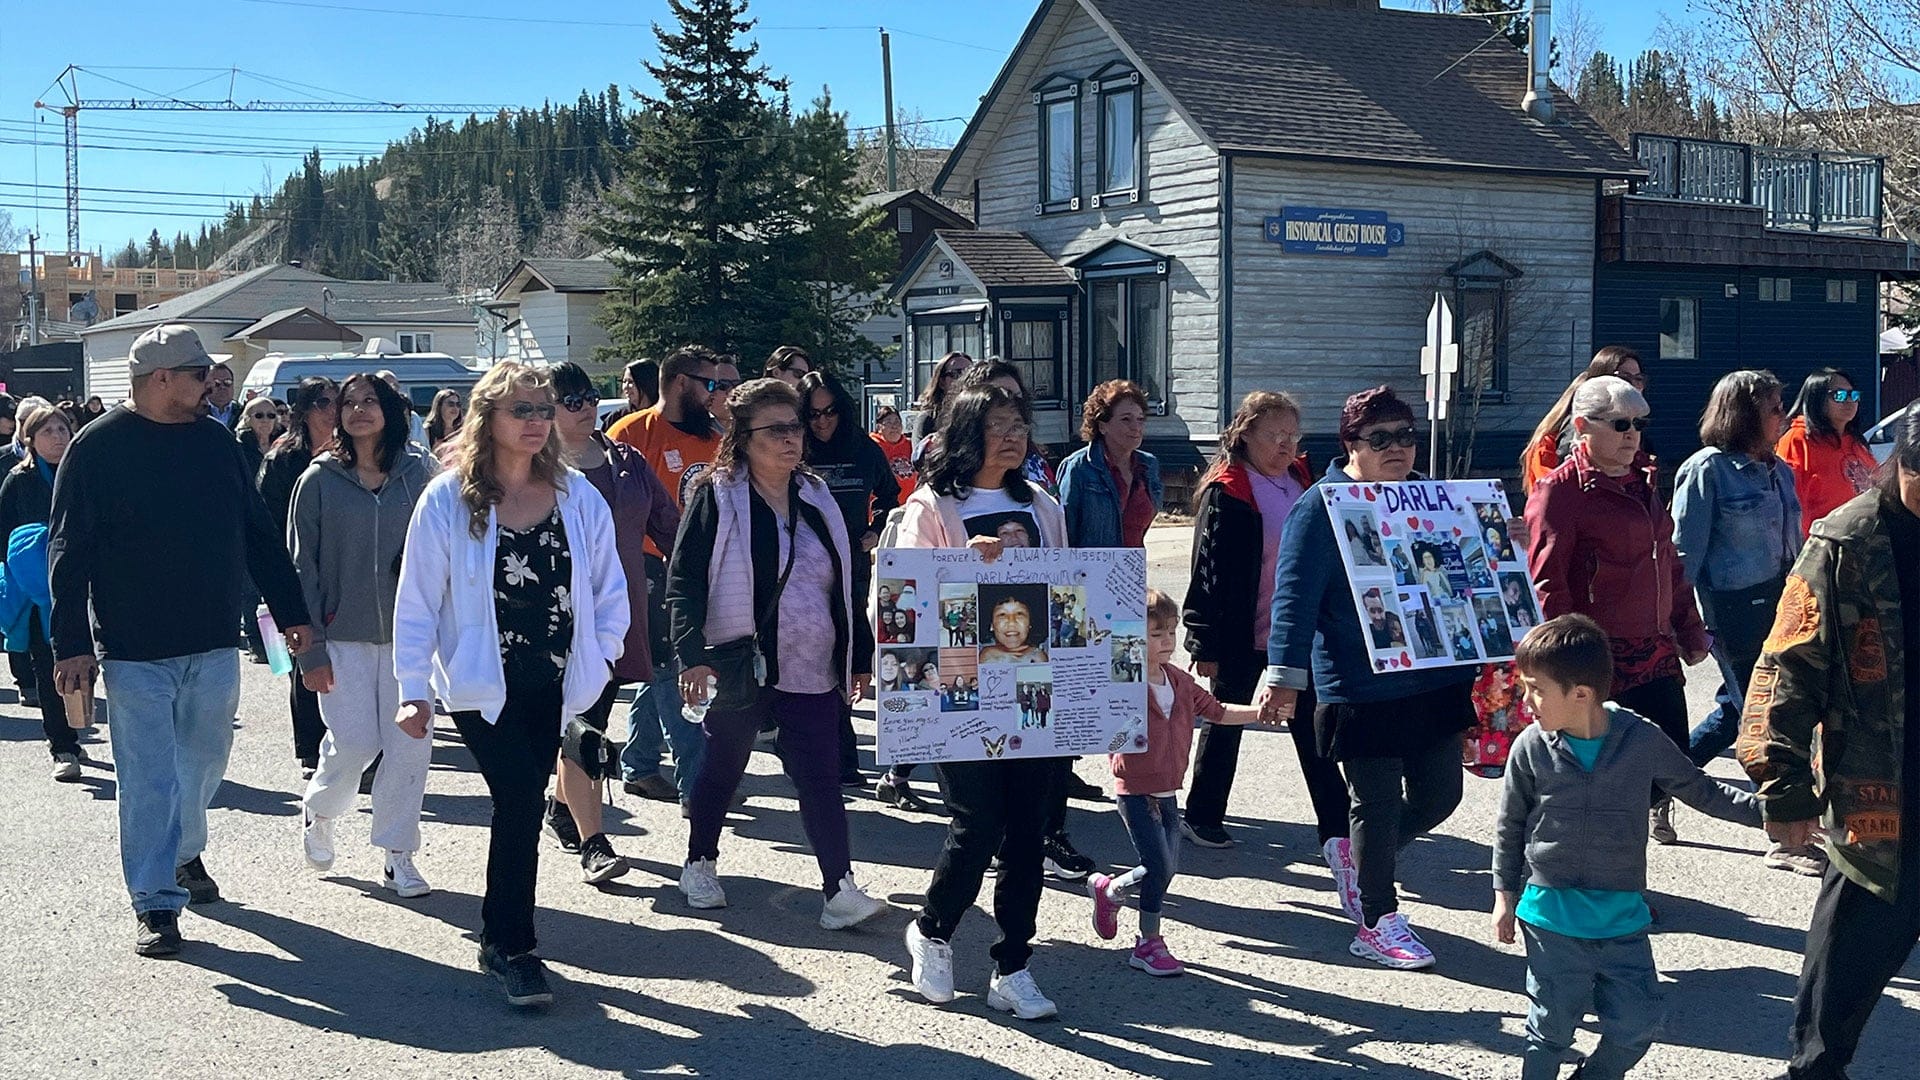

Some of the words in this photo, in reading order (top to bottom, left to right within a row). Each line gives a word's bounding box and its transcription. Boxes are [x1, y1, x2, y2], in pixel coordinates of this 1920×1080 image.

[1286, 220, 1332, 242] HISTORICAL
[1334, 223, 1360, 243] GUEST
[1361, 224, 1387, 245] HOUSE
[1383, 484, 1455, 513] DARLA
[932, 549, 968, 562] FOREVER
[1014, 549, 1060, 562] ALWAYS
